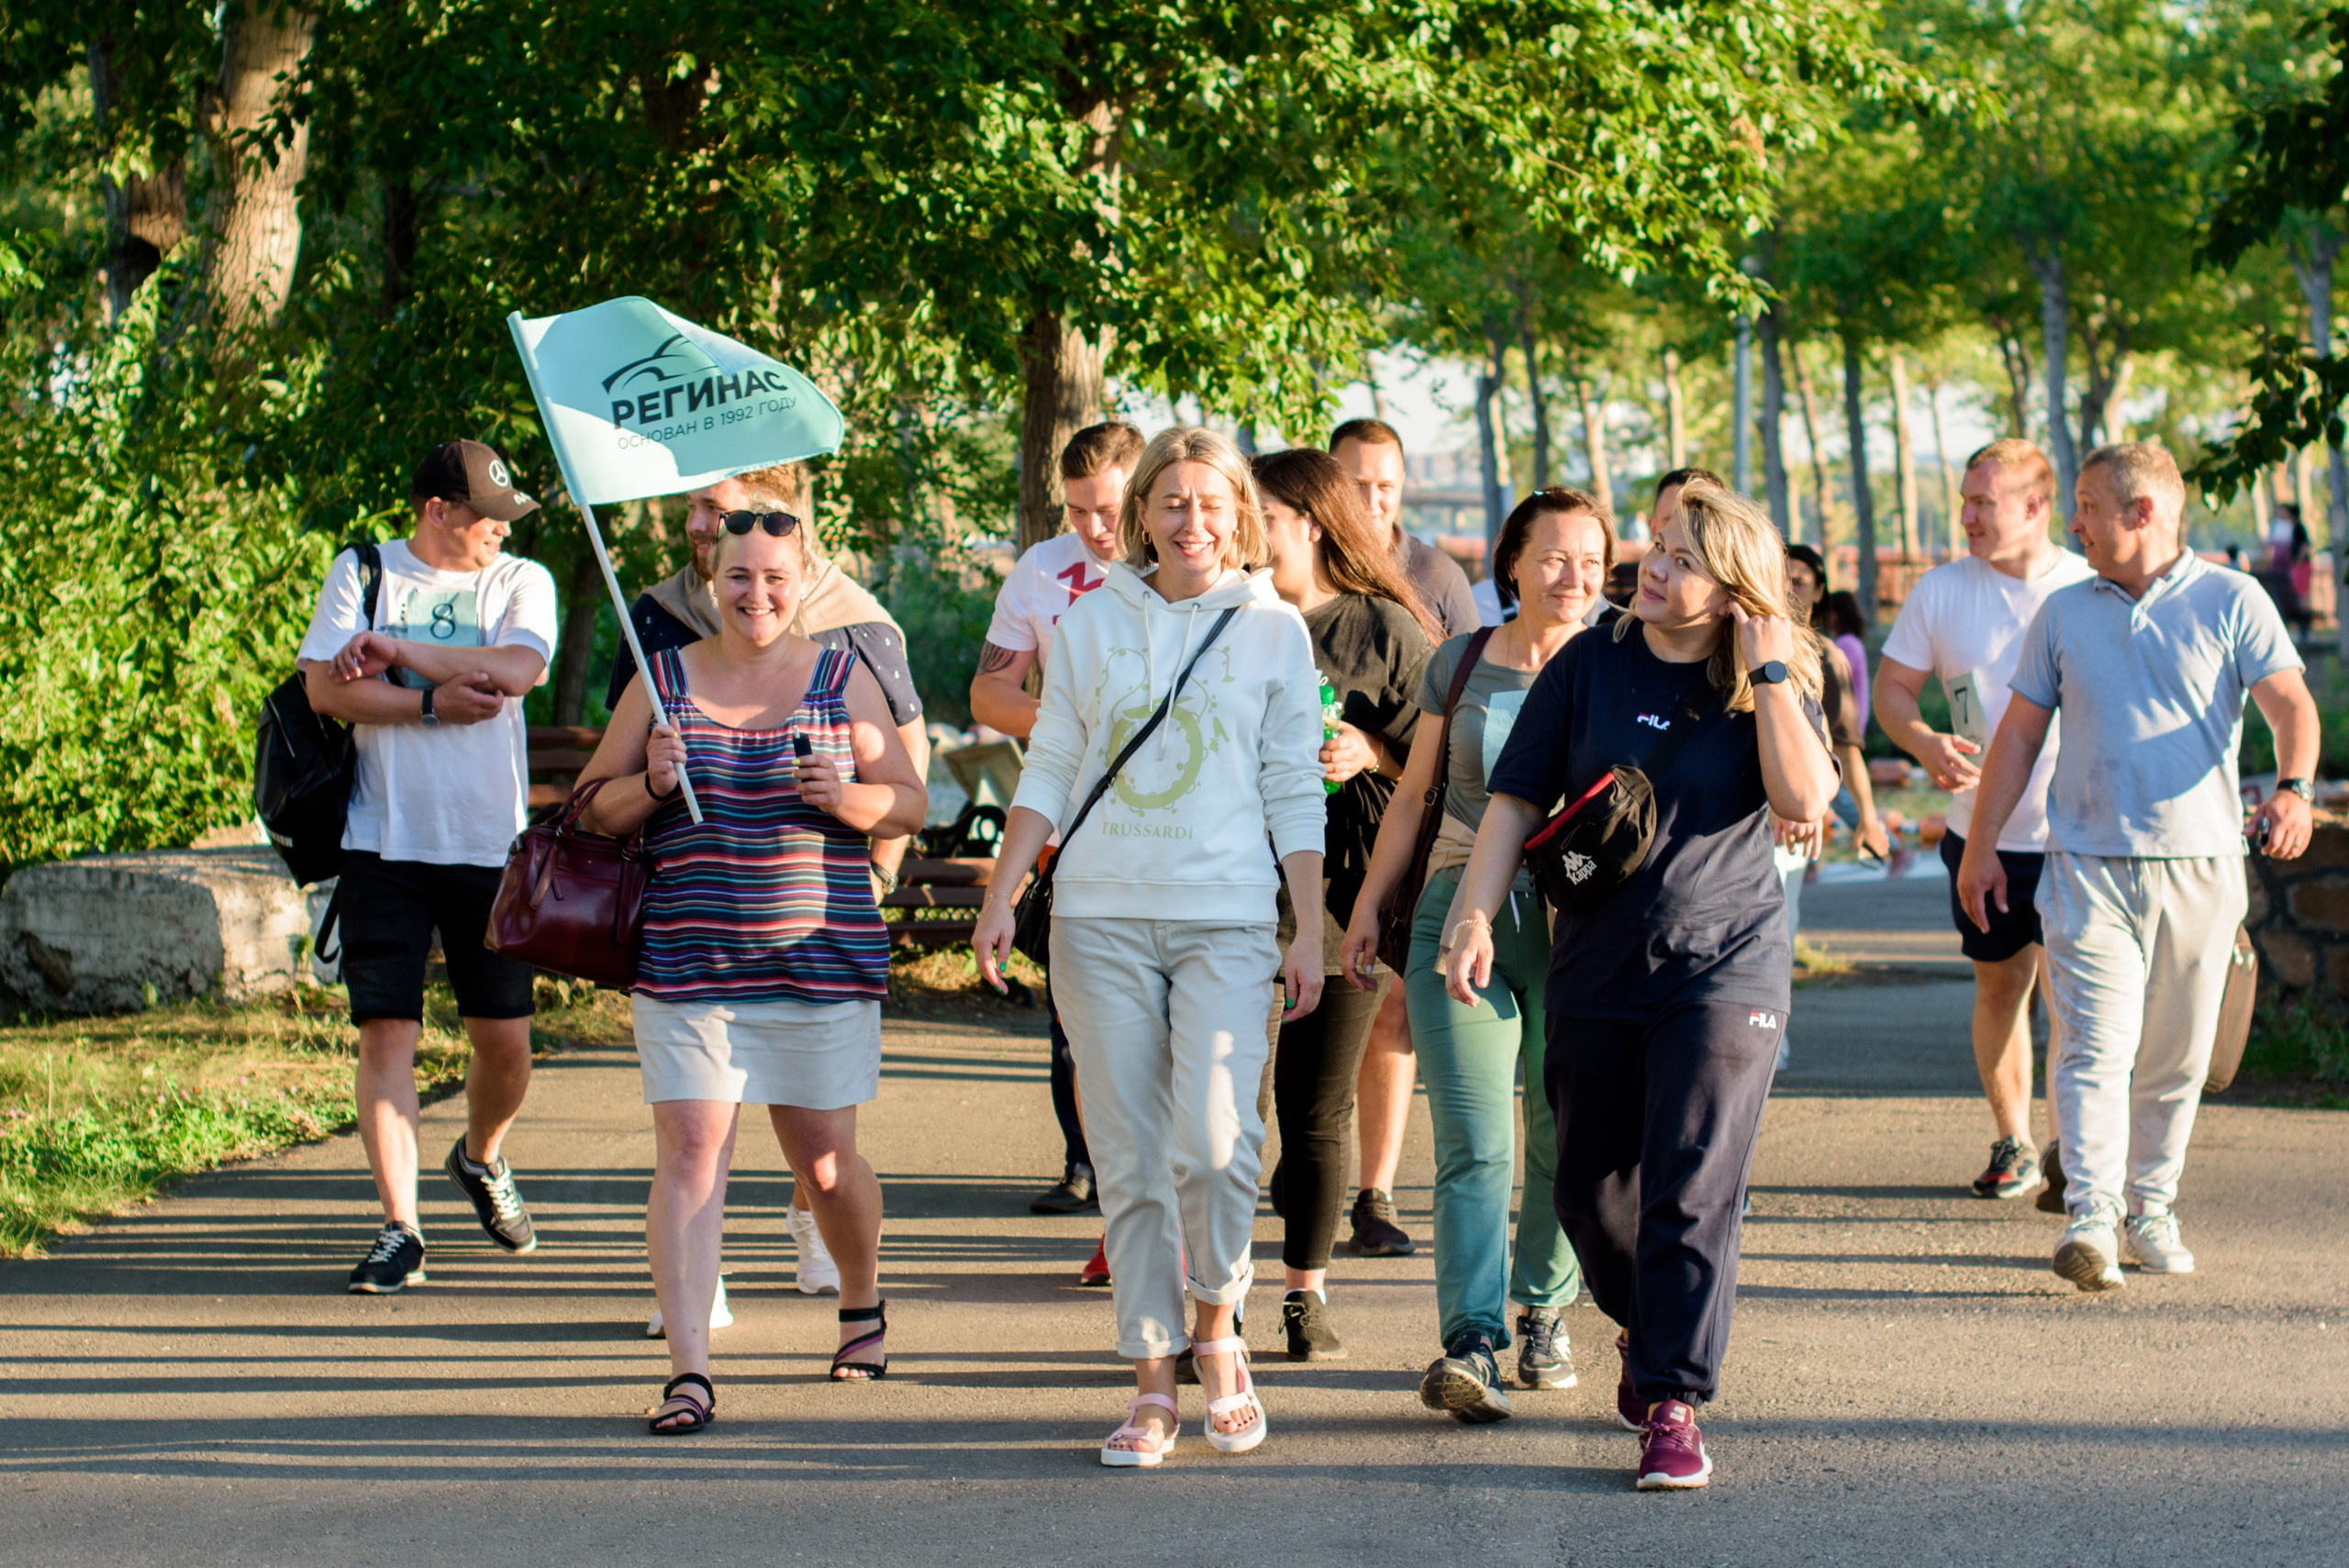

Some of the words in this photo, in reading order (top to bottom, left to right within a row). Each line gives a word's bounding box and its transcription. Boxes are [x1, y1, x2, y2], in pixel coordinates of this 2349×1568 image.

[611, 370, 789, 430] РЕГИНАС
[618, 420, 697, 450] ОСНОВАН
[704, 417, 715, 430] В
[720, 406, 753, 426] 1992
[759, 396, 797, 416] ГОДУ
[429, 603, 456, 639] 8
[1954, 686, 1969, 725] 7
[1102, 822, 1193, 840] TRUSSARDI
[1567, 860, 1598, 885] Kappa
[1749, 1011, 1776, 1029] FILA
